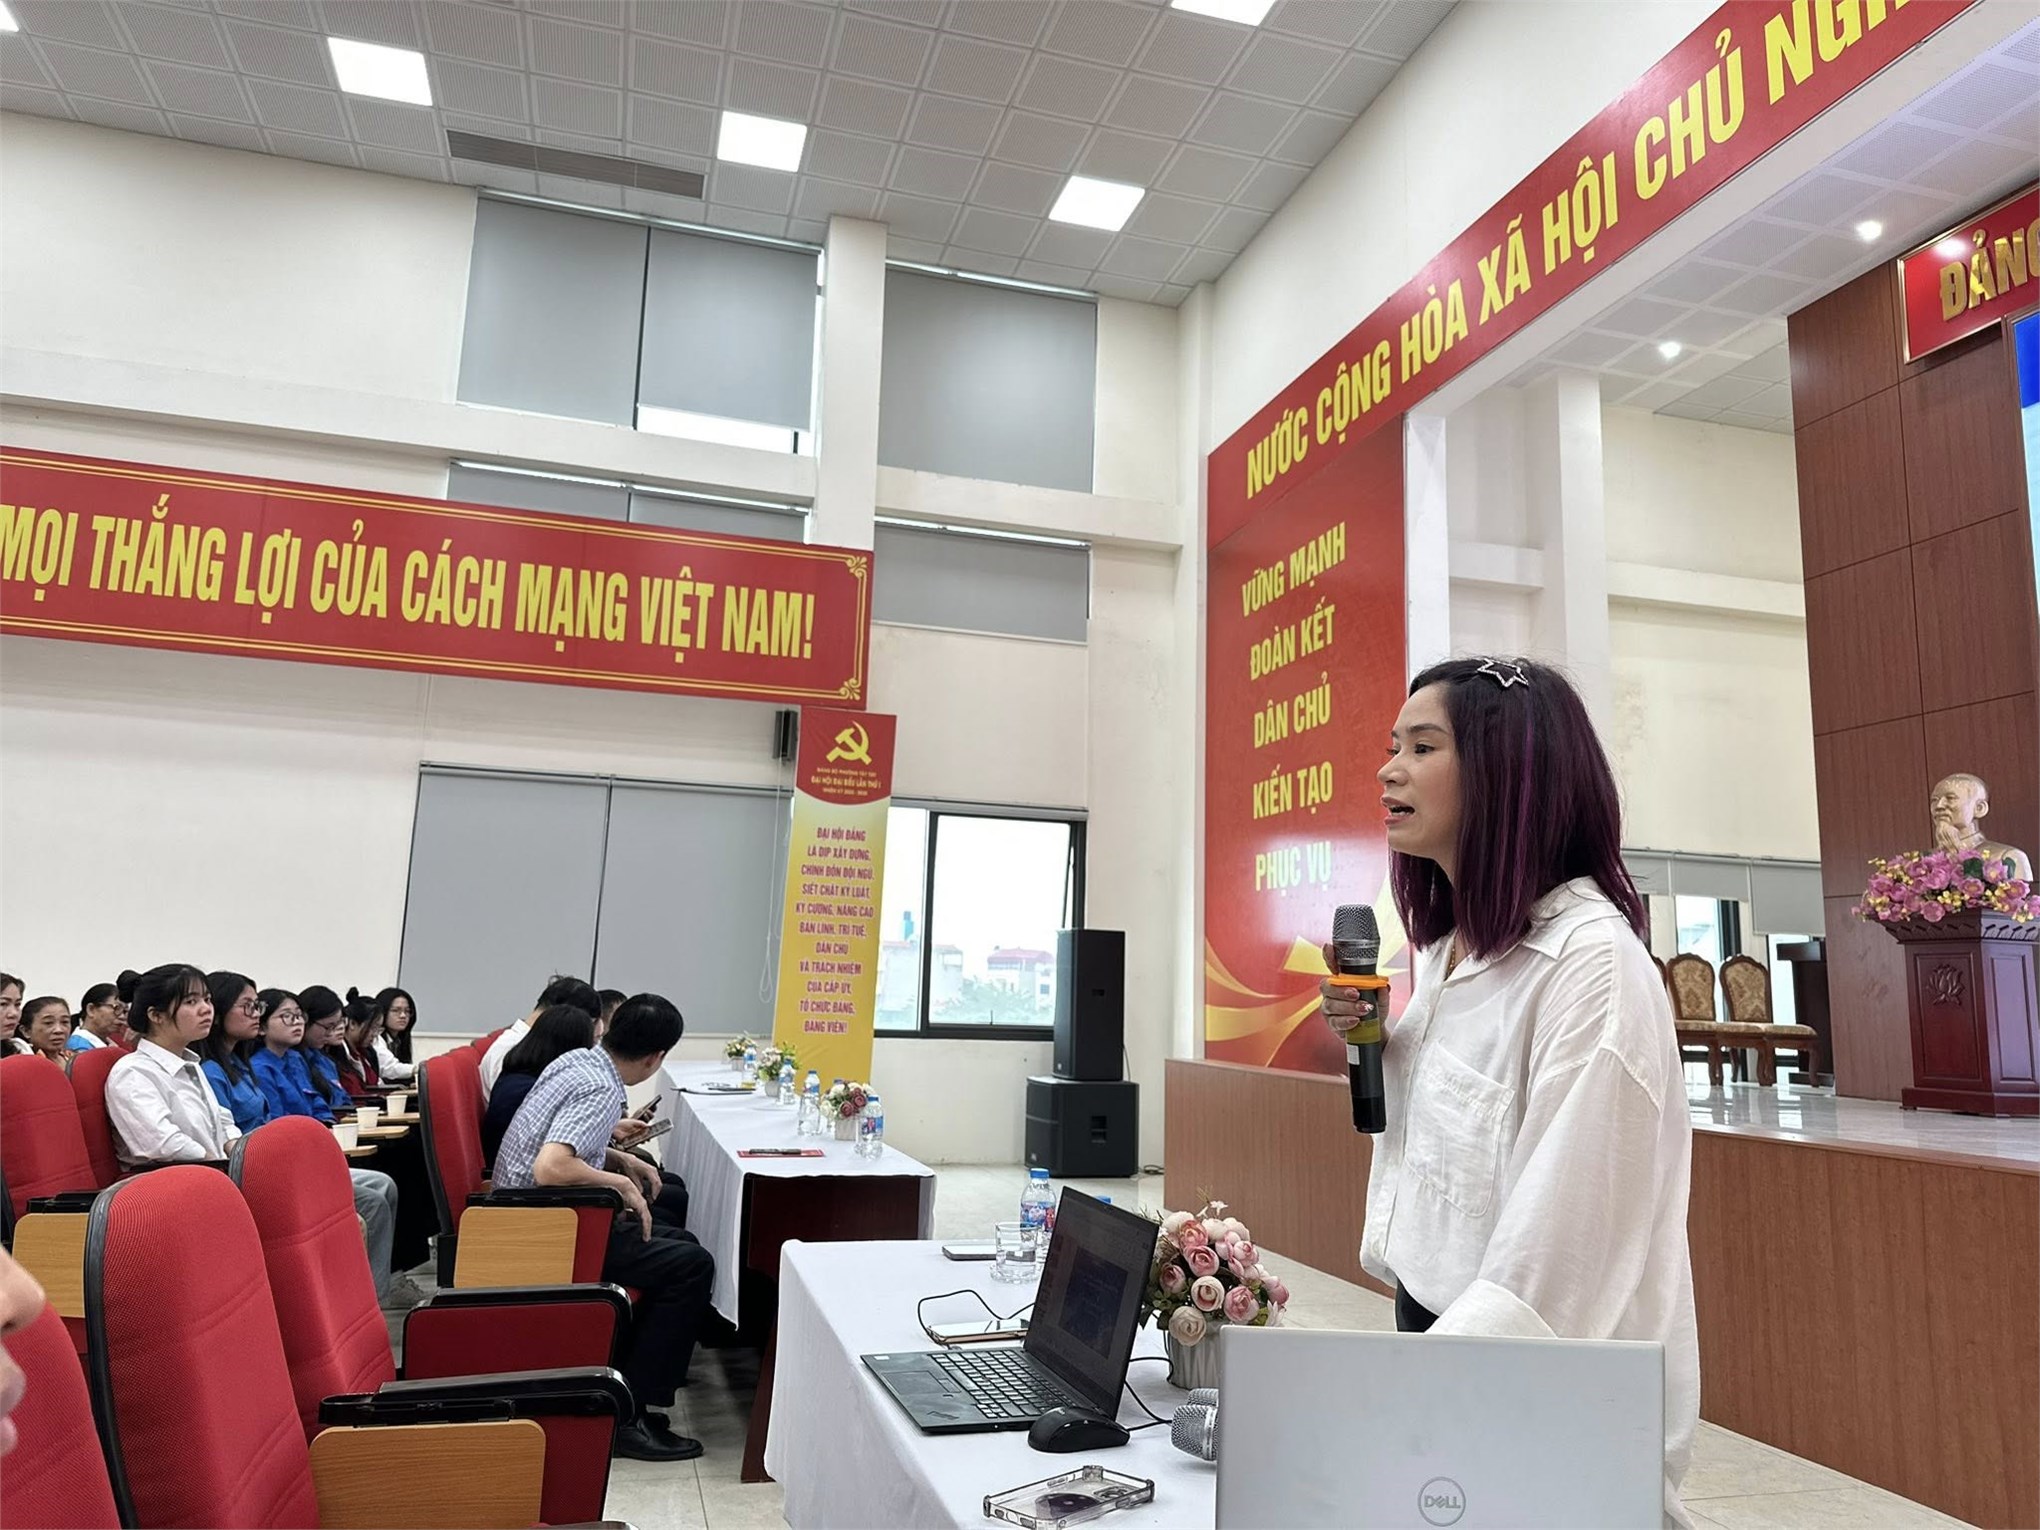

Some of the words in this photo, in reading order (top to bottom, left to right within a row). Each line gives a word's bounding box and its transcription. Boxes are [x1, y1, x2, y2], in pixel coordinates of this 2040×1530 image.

[1247, 409, 1309, 499] NƯỚC
[1316, 340, 1391, 444] CỘNG
[1400, 284, 1469, 384] HÒA
[1476, 213, 1532, 326] XÃ
[1542, 151, 1618, 275] HỘI
[1634, 28, 1745, 200] CHỦ
[1242, 561, 1285, 617] VỮNG
[1290, 521, 1346, 587] MẠNH
[0, 504, 79, 602] MỌI
[89, 494, 227, 601] THẮNG
[234, 528, 302, 624] LỢI
[310, 518, 388, 618] CỦA
[401, 538, 506, 630] CÁCH
[514, 563, 629, 652] MẠNG
[640, 566, 715, 663] VIỆT
[722, 585, 816, 659] NAM!
[1250, 626, 1295, 680] ĐOÀN
[1300, 595, 1336, 658] KẾT
[1254, 700, 1288, 749] DÂN
[1293, 671, 1331, 735] CHỦ
[1253, 763, 1292, 819] KIẾN
[1297, 761, 1333, 815] TẠO
[817, 827, 830, 841] ĐẠI
[831, 826, 844, 842] HỘI
[846, 826, 866, 841] ĐẢNG
[808, 844, 816, 856] LÀ
[833, 846, 847, 858] XÂY
[843, 866, 856, 880] ĐỘI
[1255, 847, 1301, 896] PHỤC
[1306, 841, 1332, 892] VỤ
[837, 903, 857, 916] NÂNG
[859, 905, 874, 917] CAO
[816, 941, 831, 954] DÂN
[800, 959, 809, 972] VÀ
[812, 960, 835, 973] TRÁCH
[837, 962, 861, 974] NHIỆM
[807, 978, 822, 992] CỦA
[824, 979, 839, 993] CẤP
[800, 999, 809, 1012] TỔ
[811, 1000, 831, 1013] CHỨC
[805, 1018, 825, 1032] ĐẢNG
[1424, 1495, 1461, 1508] DELL
